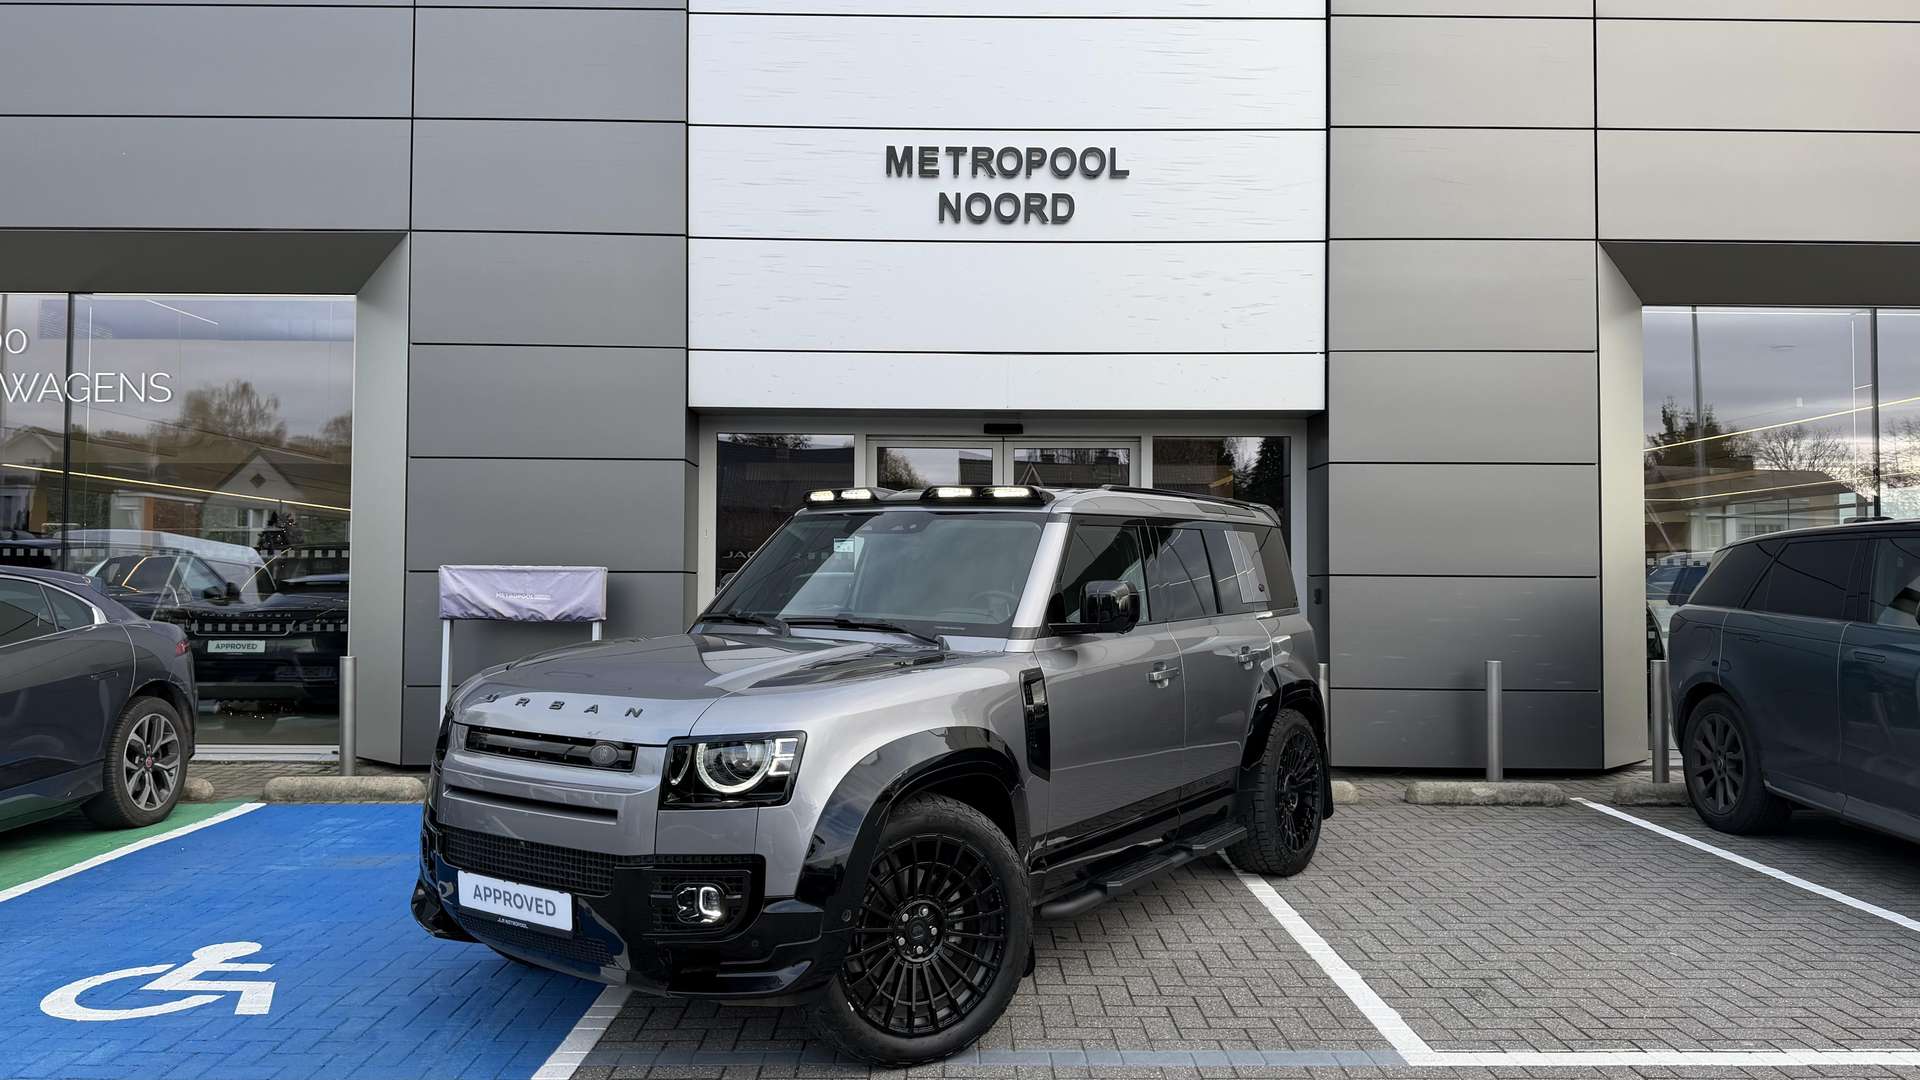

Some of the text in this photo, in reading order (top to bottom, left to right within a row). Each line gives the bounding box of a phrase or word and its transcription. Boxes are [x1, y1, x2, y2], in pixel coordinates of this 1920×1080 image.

[885, 145, 1130, 179] METROPOOL
[938, 192, 1075, 225] NOORD
[0, 372, 173, 403] WAGENS
[485, 694, 643, 718] URBAN
[473, 884, 557, 916] APPROVED
